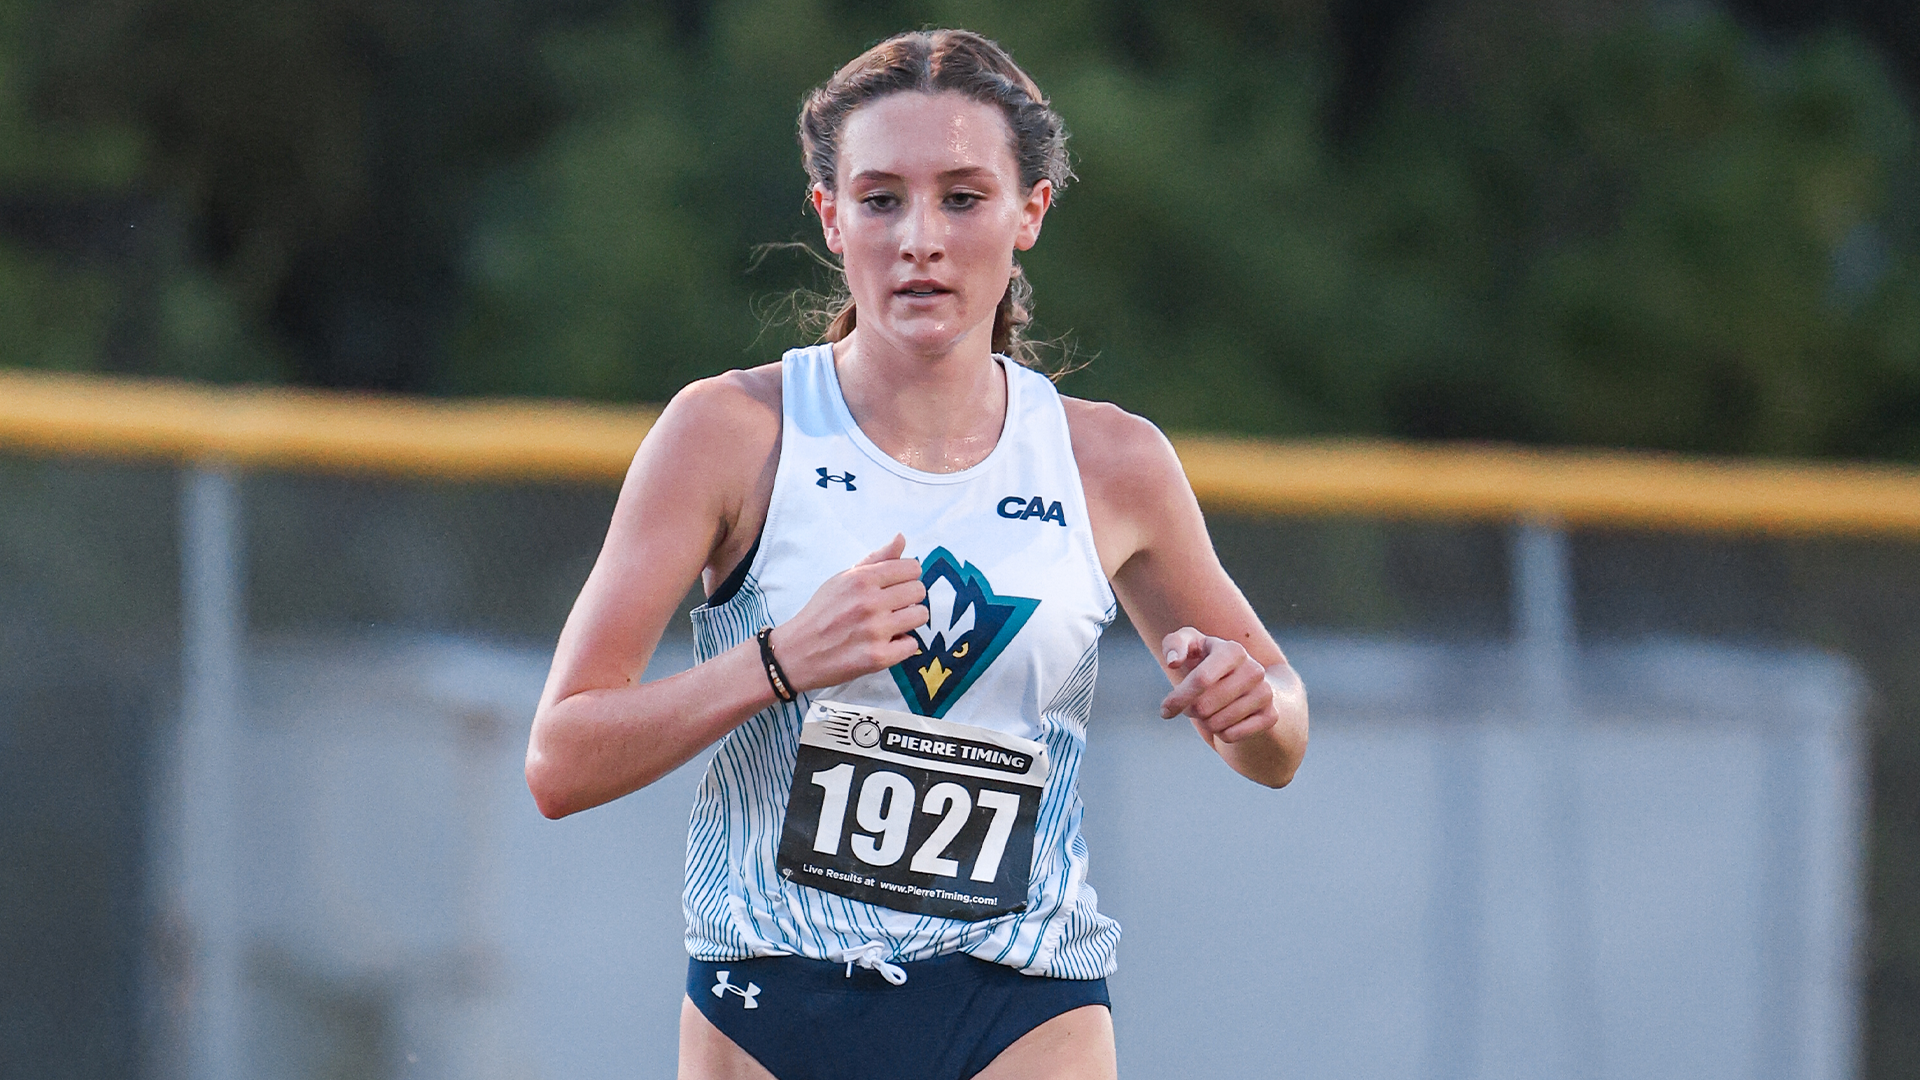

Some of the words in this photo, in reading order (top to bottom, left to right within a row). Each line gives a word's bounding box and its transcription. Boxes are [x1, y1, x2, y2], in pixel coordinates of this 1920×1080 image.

[996, 495, 1067, 527] CAA
[886, 733, 957, 757] PIERRE
[960, 745, 1026, 769] TIMING
[811, 762, 1021, 883] 1927
[803, 863, 824, 877] Live
[826, 868, 863, 885] Results
[864, 877, 875, 887] at
[880, 881, 998, 906] www.PierreTiming.com!
